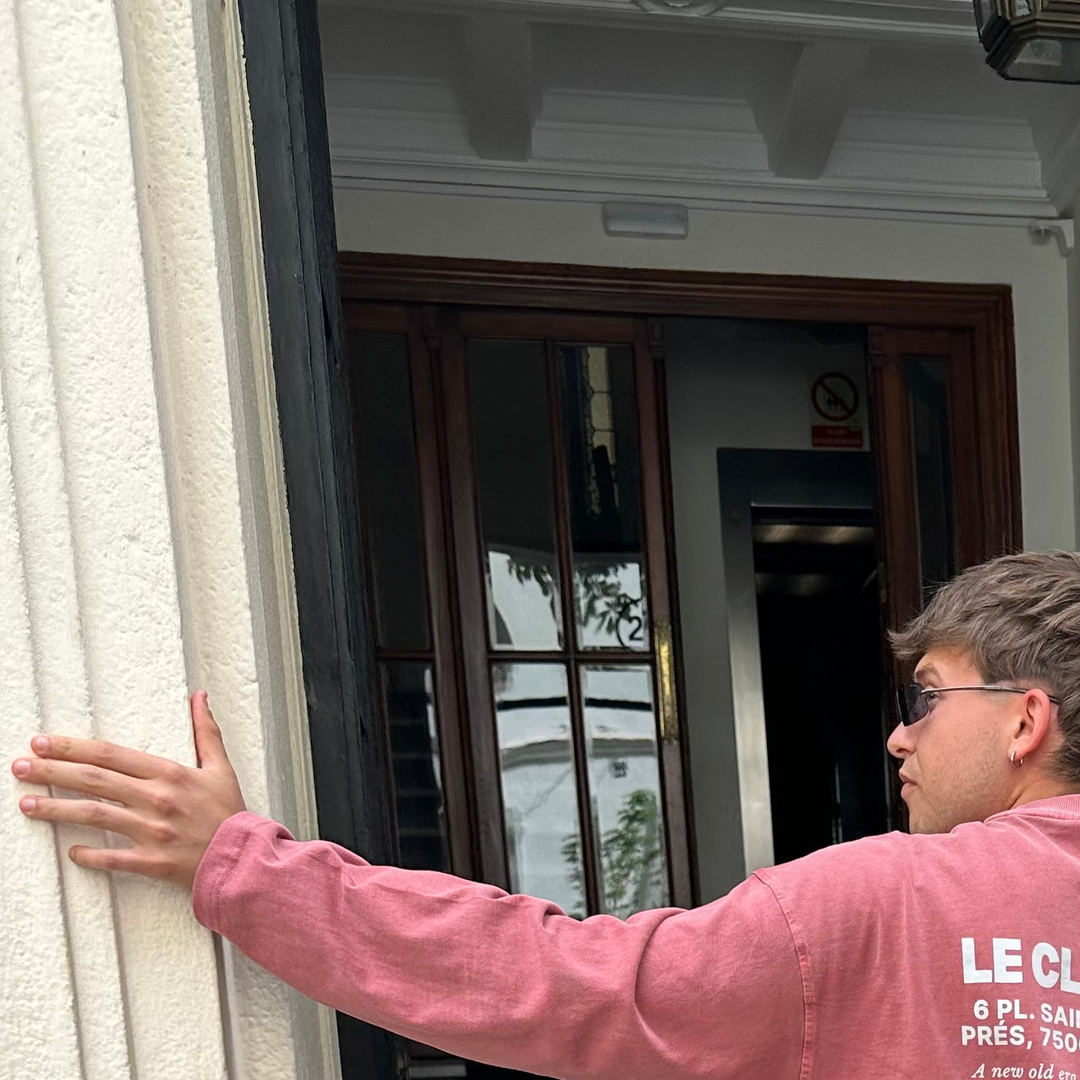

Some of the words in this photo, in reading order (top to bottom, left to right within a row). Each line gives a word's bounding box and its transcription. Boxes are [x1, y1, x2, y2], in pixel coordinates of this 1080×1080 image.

[962, 937, 1023, 983] LE
[974, 1000, 989, 1019] 6
[997, 1000, 1035, 1019] PL.
[961, 1020, 1032, 1050] PRÉS,
[971, 1064, 985, 1078] A
[992, 1066, 1024, 1078] new
[1028, 1064, 1054, 1080] old
